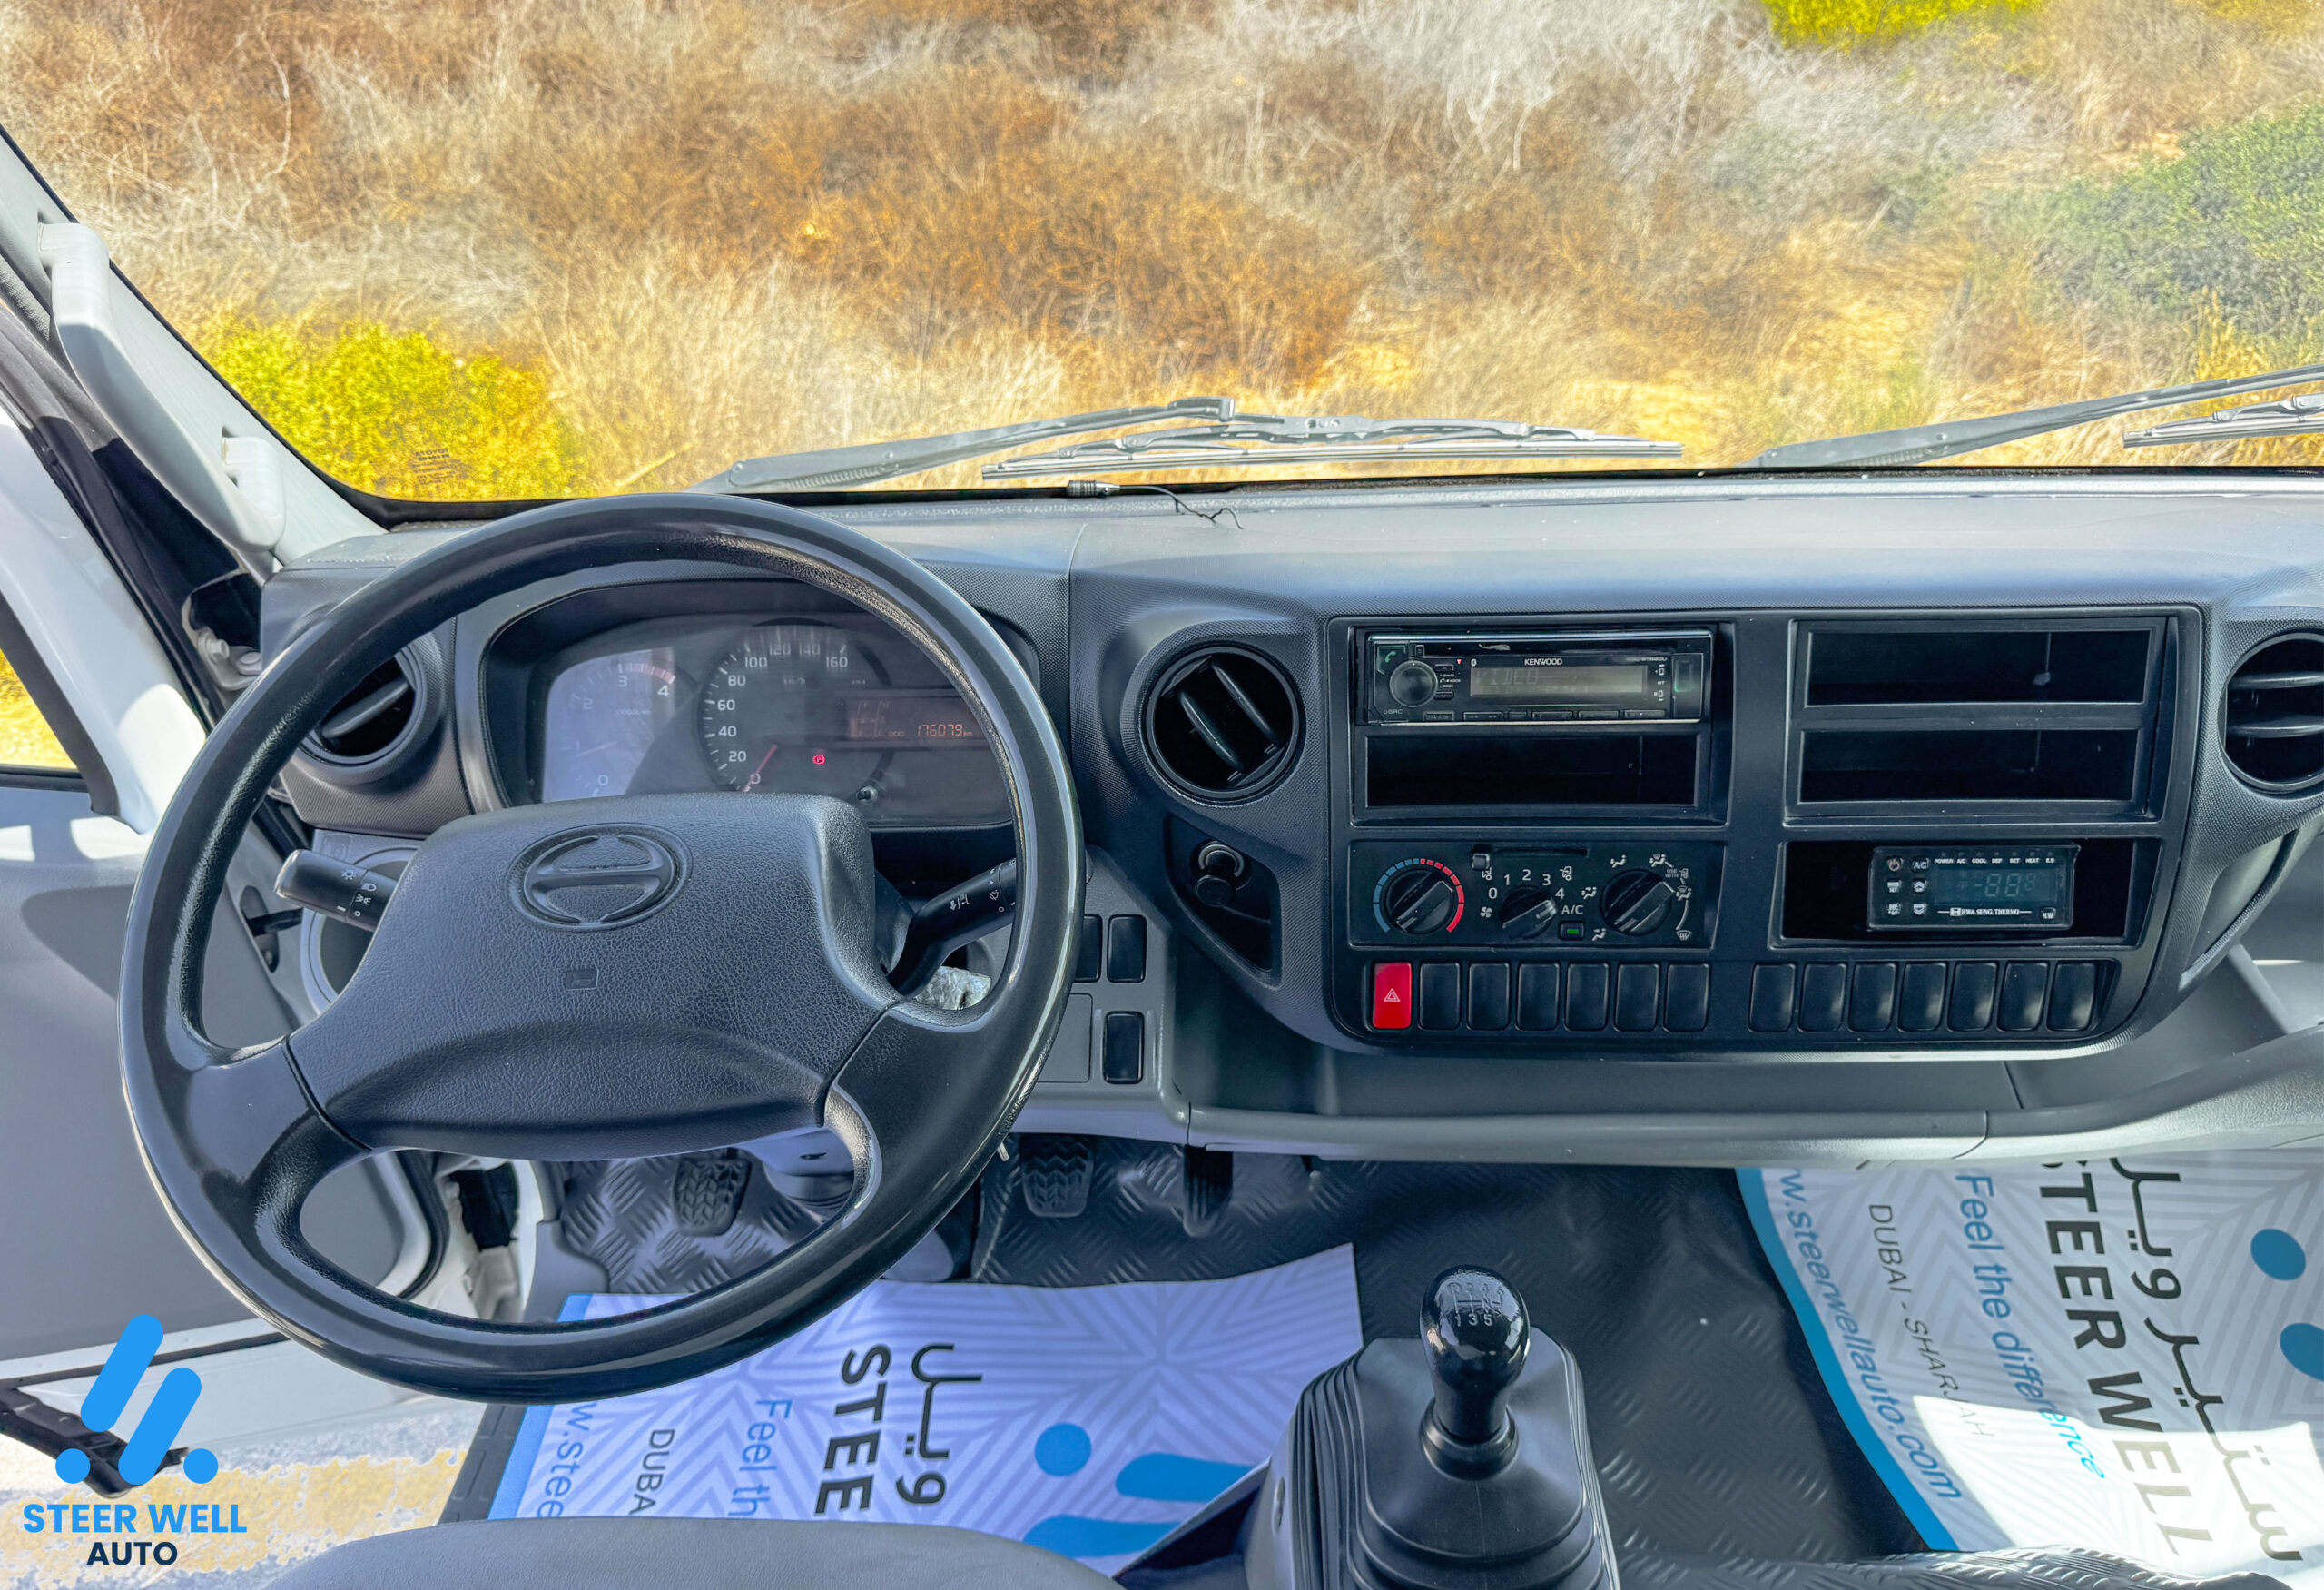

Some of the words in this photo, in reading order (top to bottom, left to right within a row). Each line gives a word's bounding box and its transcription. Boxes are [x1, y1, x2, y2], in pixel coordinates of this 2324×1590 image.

[799, 644, 821, 656] 140
[744, 657, 768, 668] 100
[826, 657, 848, 668] 160
[1524, 658, 1563, 667] KENWOOD
[617, 676, 628, 687] 3
[727, 675, 747, 686] 80
[657, 685, 670, 697] 4
[583, 698, 594, 710] 2
[717, 699, 736, 711] 60
[718, 726, 737, 737] 40
[729, 750, 747, 762] 20
[597, 774, 609, 786] 0
[1913, 861, 1927, 869] A/C
[1504, 874, 1510, 885] 1
[1521, 869, 1531, 881] 2
[1542, 874, 1551, 885] 3
[1488, 887, 1498, 899] 0
[1555, 887, 1565, 899] 4
[1561, 904, 1583, 914] A/C
[1955, 1174, 2005, 1251] Feel
[1973, 1263, 2013, 1318] the
[1468, 1313, 1478, 1326] 3
[1483, 1313, 1493, 1327] 5
[1868, 1204, 1912, 1293] DUBAI
[1905, 1318, 1995, 1437] SHARJAH
[2039, 1160, 2127, 1350] TEER
[2087, 1371, 2214, 1556] WELL
[1991, 1331, 2105, 1479] difference
[815, 1343, 892, 1516] STEE
[895, 1342, 983, 1506] ويل
[740, 1399, 793, 1471] Feel
[2143, 1317, 2303, 1562] ستير
[628, 1428, 675, 1515] DUBA
[728, 1484, 770, 1516] th
